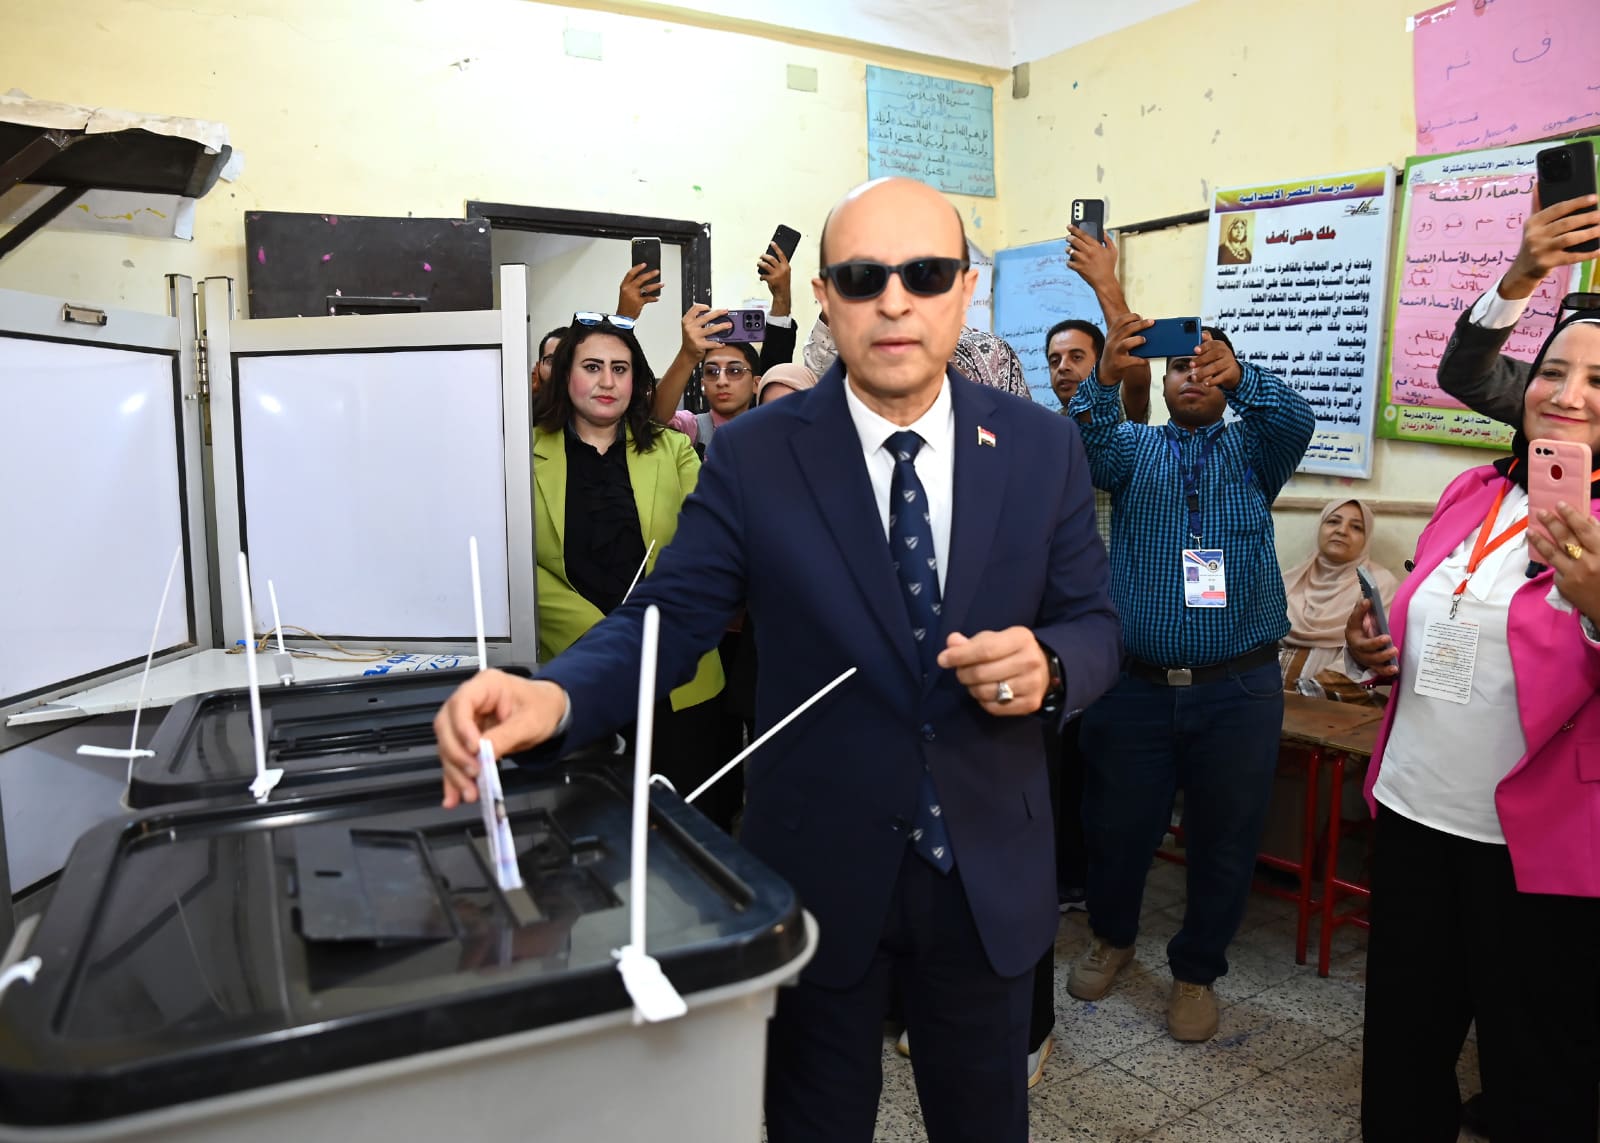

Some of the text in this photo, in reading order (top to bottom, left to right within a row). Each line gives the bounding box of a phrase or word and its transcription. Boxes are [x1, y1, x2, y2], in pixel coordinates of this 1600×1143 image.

[1240, 182, 1355, 203] مدرسة النصر الابتدائية
[1265, 230, 1289, 244] ناصف
[1316, 225, 1337, 240] ملك
[1303, 260, 1329, 274] الجمالية
[1354, 259, 1372, 271] ولدت
[1280, 278, 1293, 287] ملك
[1295, 277, 1320, 288] وحصلت
[1345, 274, 1371, 287] بالمدرسة
[1318, 291, 1343, 303] دراستها
[1344, 290, 1370, 303] وواصلت
[1342, 305, 1369, 318] وانتقلت
[1327, 321, 1341, 331] ملك
[1337, 336, 1367, 350] وتعليمها
[1344, 351, 1365, 364] وكانت
[1352, 385, 1362, 395] من
[1307, 396, 1331, 409] والمجتم
